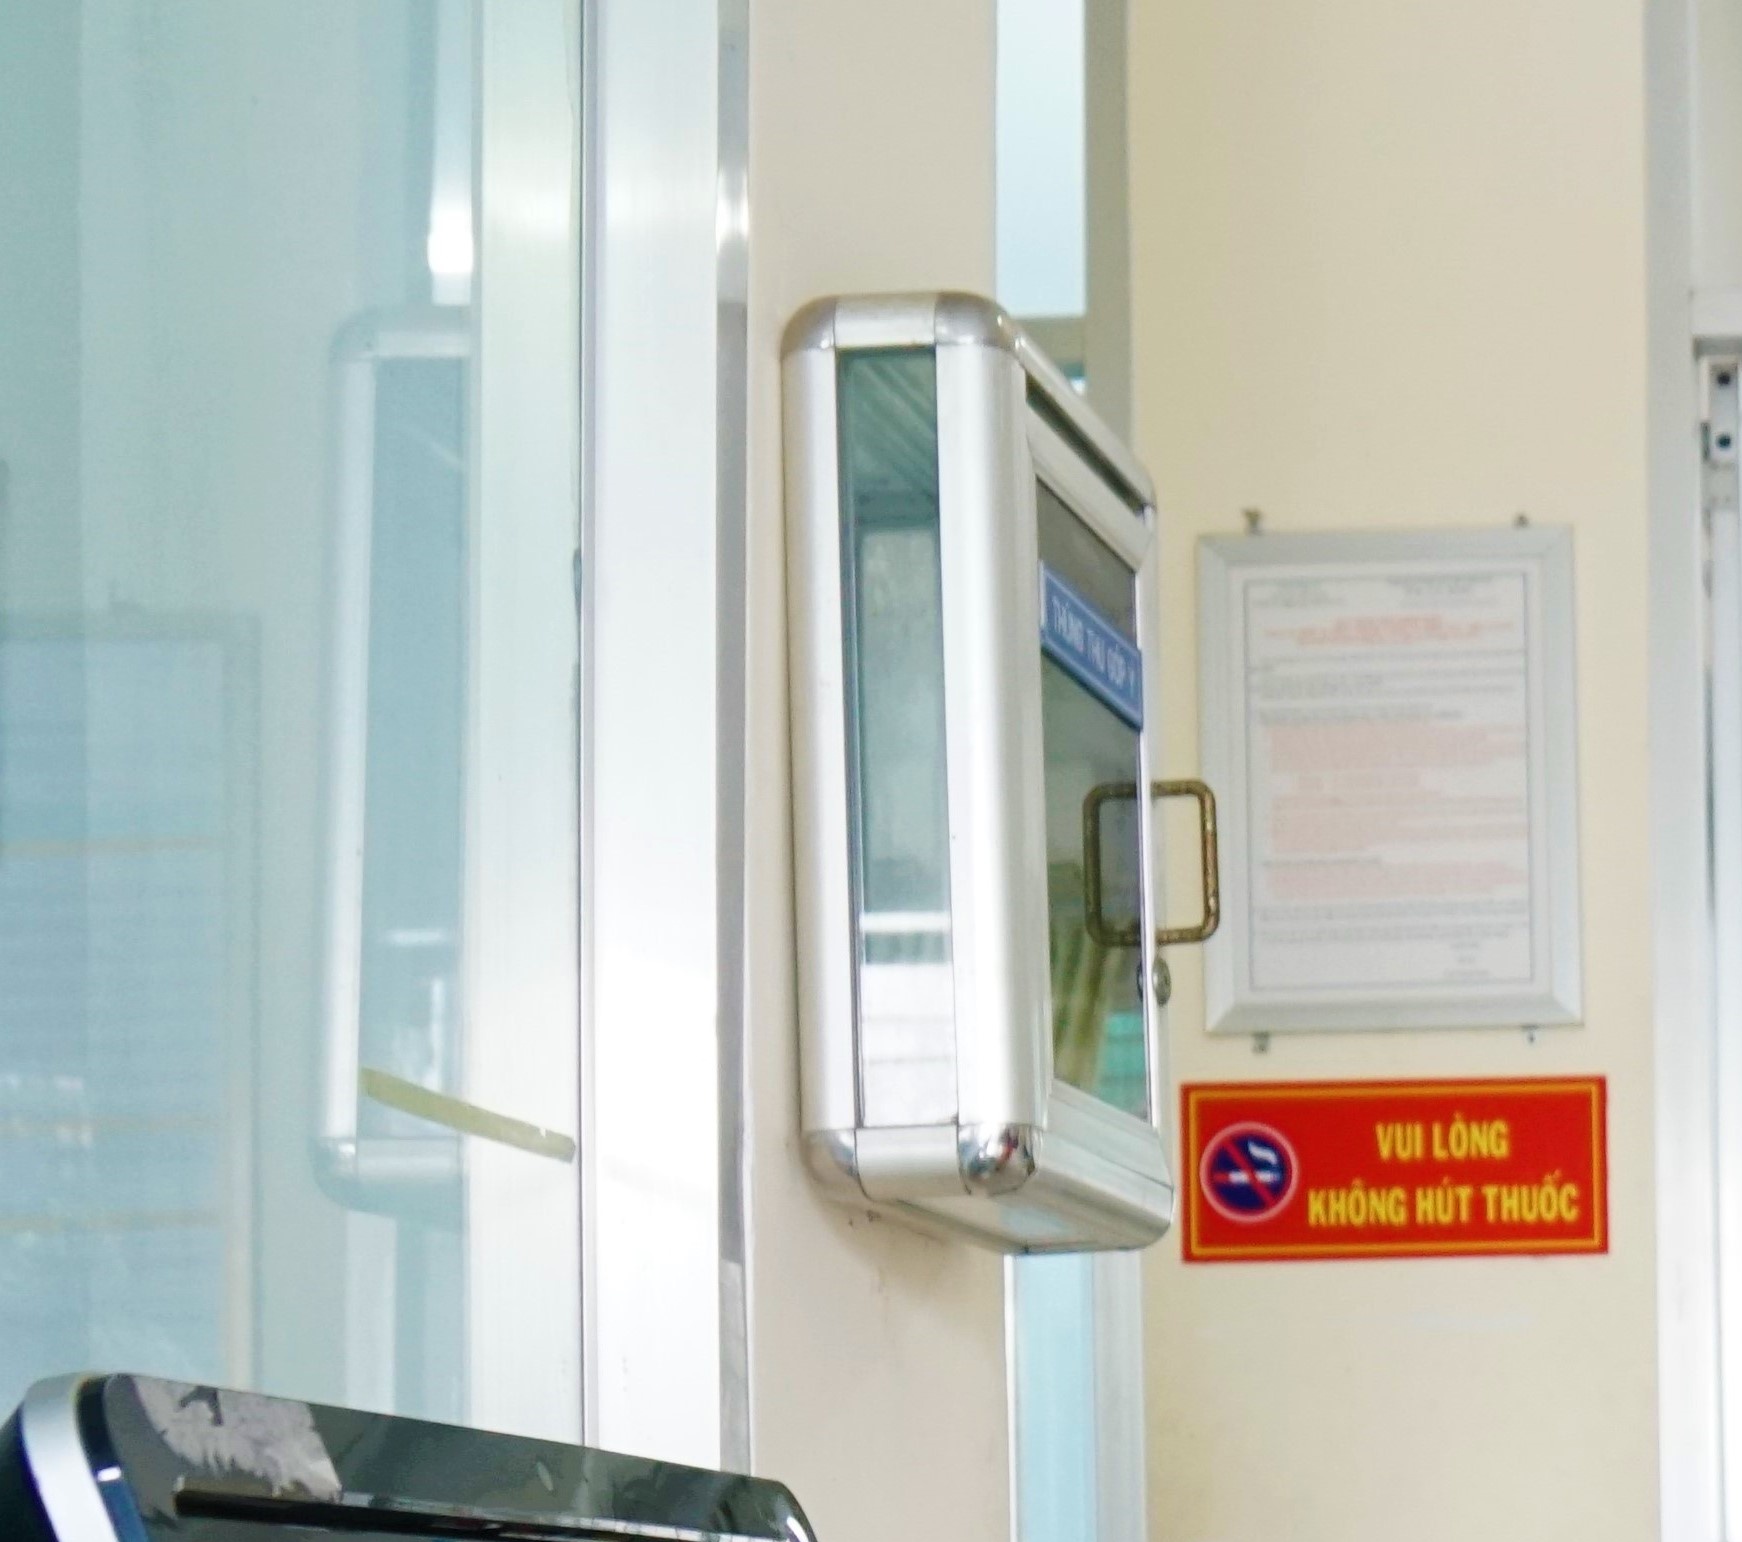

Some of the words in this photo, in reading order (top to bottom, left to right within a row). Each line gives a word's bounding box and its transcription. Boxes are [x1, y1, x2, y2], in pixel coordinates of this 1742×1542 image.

[1374, 1121, 1423, 1161] VUI
[1431, 1110, 1509, 1160] LÒNG
[1307, 1177, 1408, 1227] KHÔNG
[1415, 1175, 1473, 1224] HÚT
[1481, 1167, 1580, 1224] THUỐC
